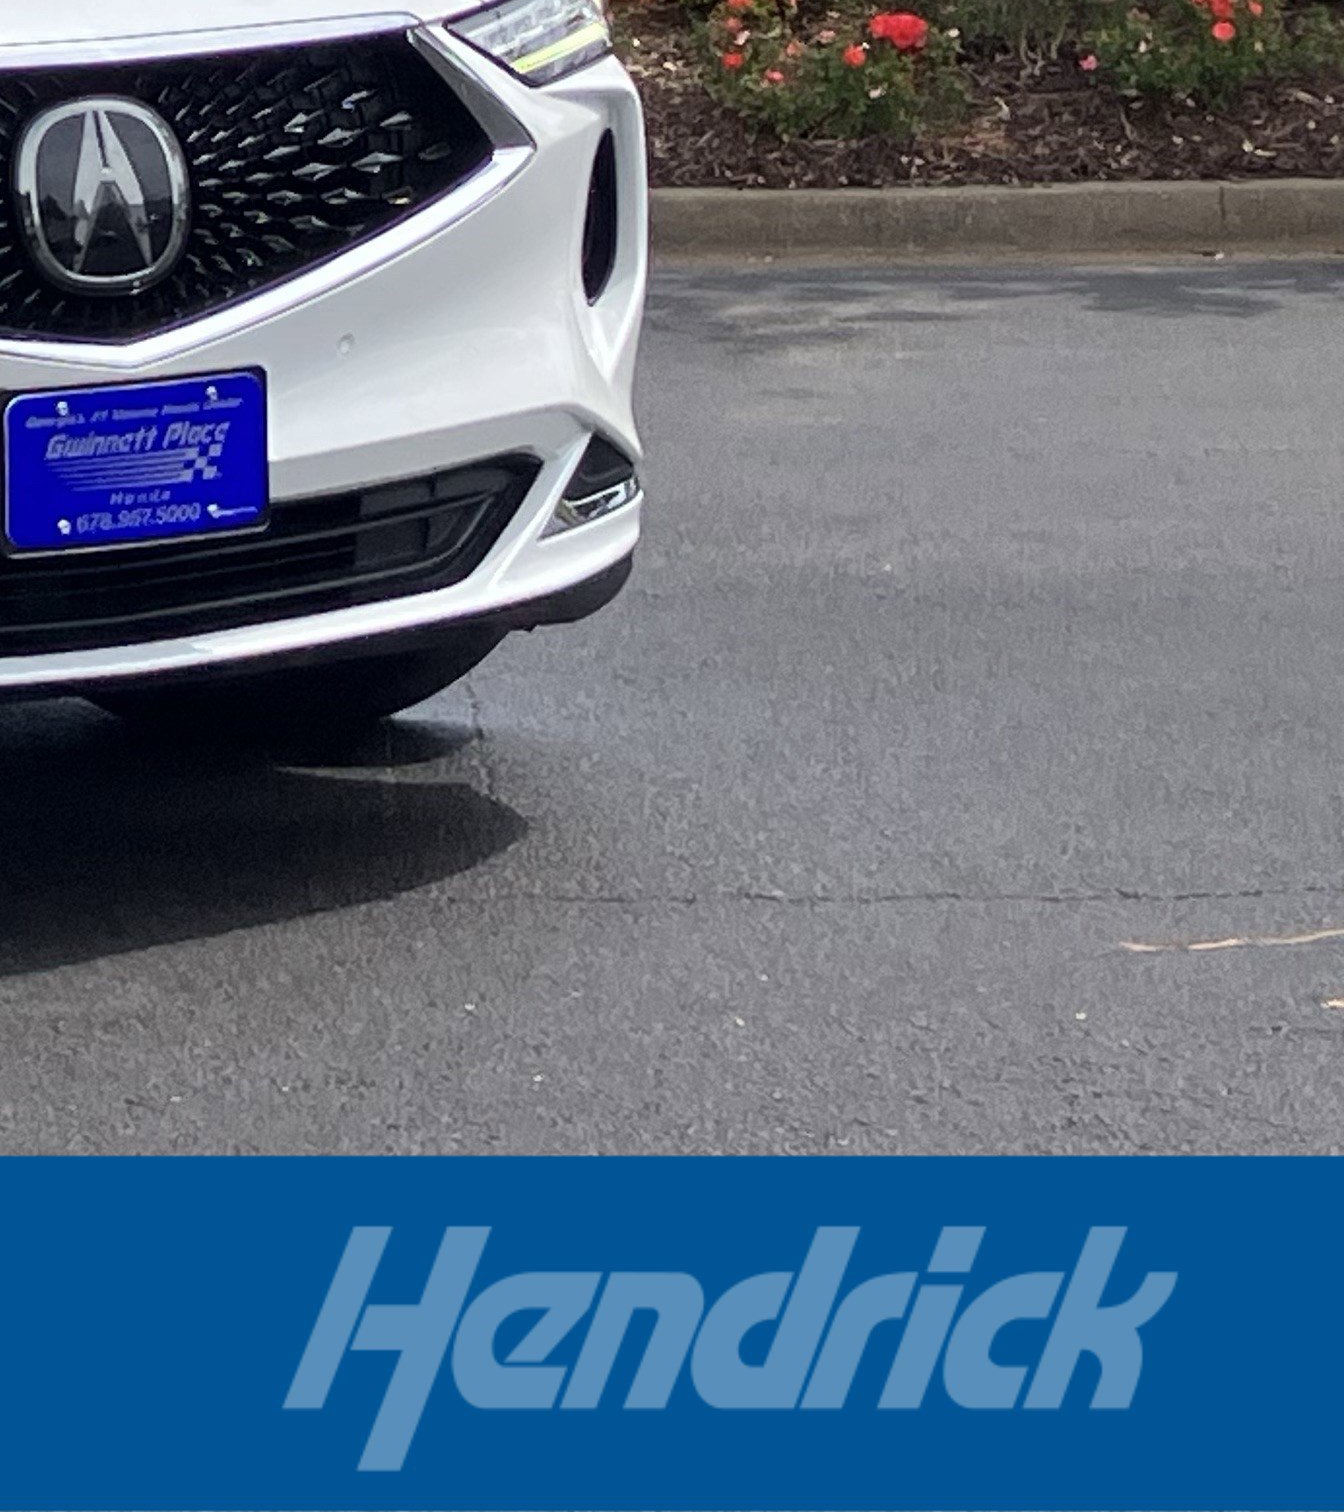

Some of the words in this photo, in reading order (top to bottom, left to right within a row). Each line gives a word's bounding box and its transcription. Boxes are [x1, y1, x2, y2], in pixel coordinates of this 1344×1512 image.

[45, 426, 158, 460] Gwinnett
[163, 421, 230, 449] Place
[109, 489, 170, 505] Honda
